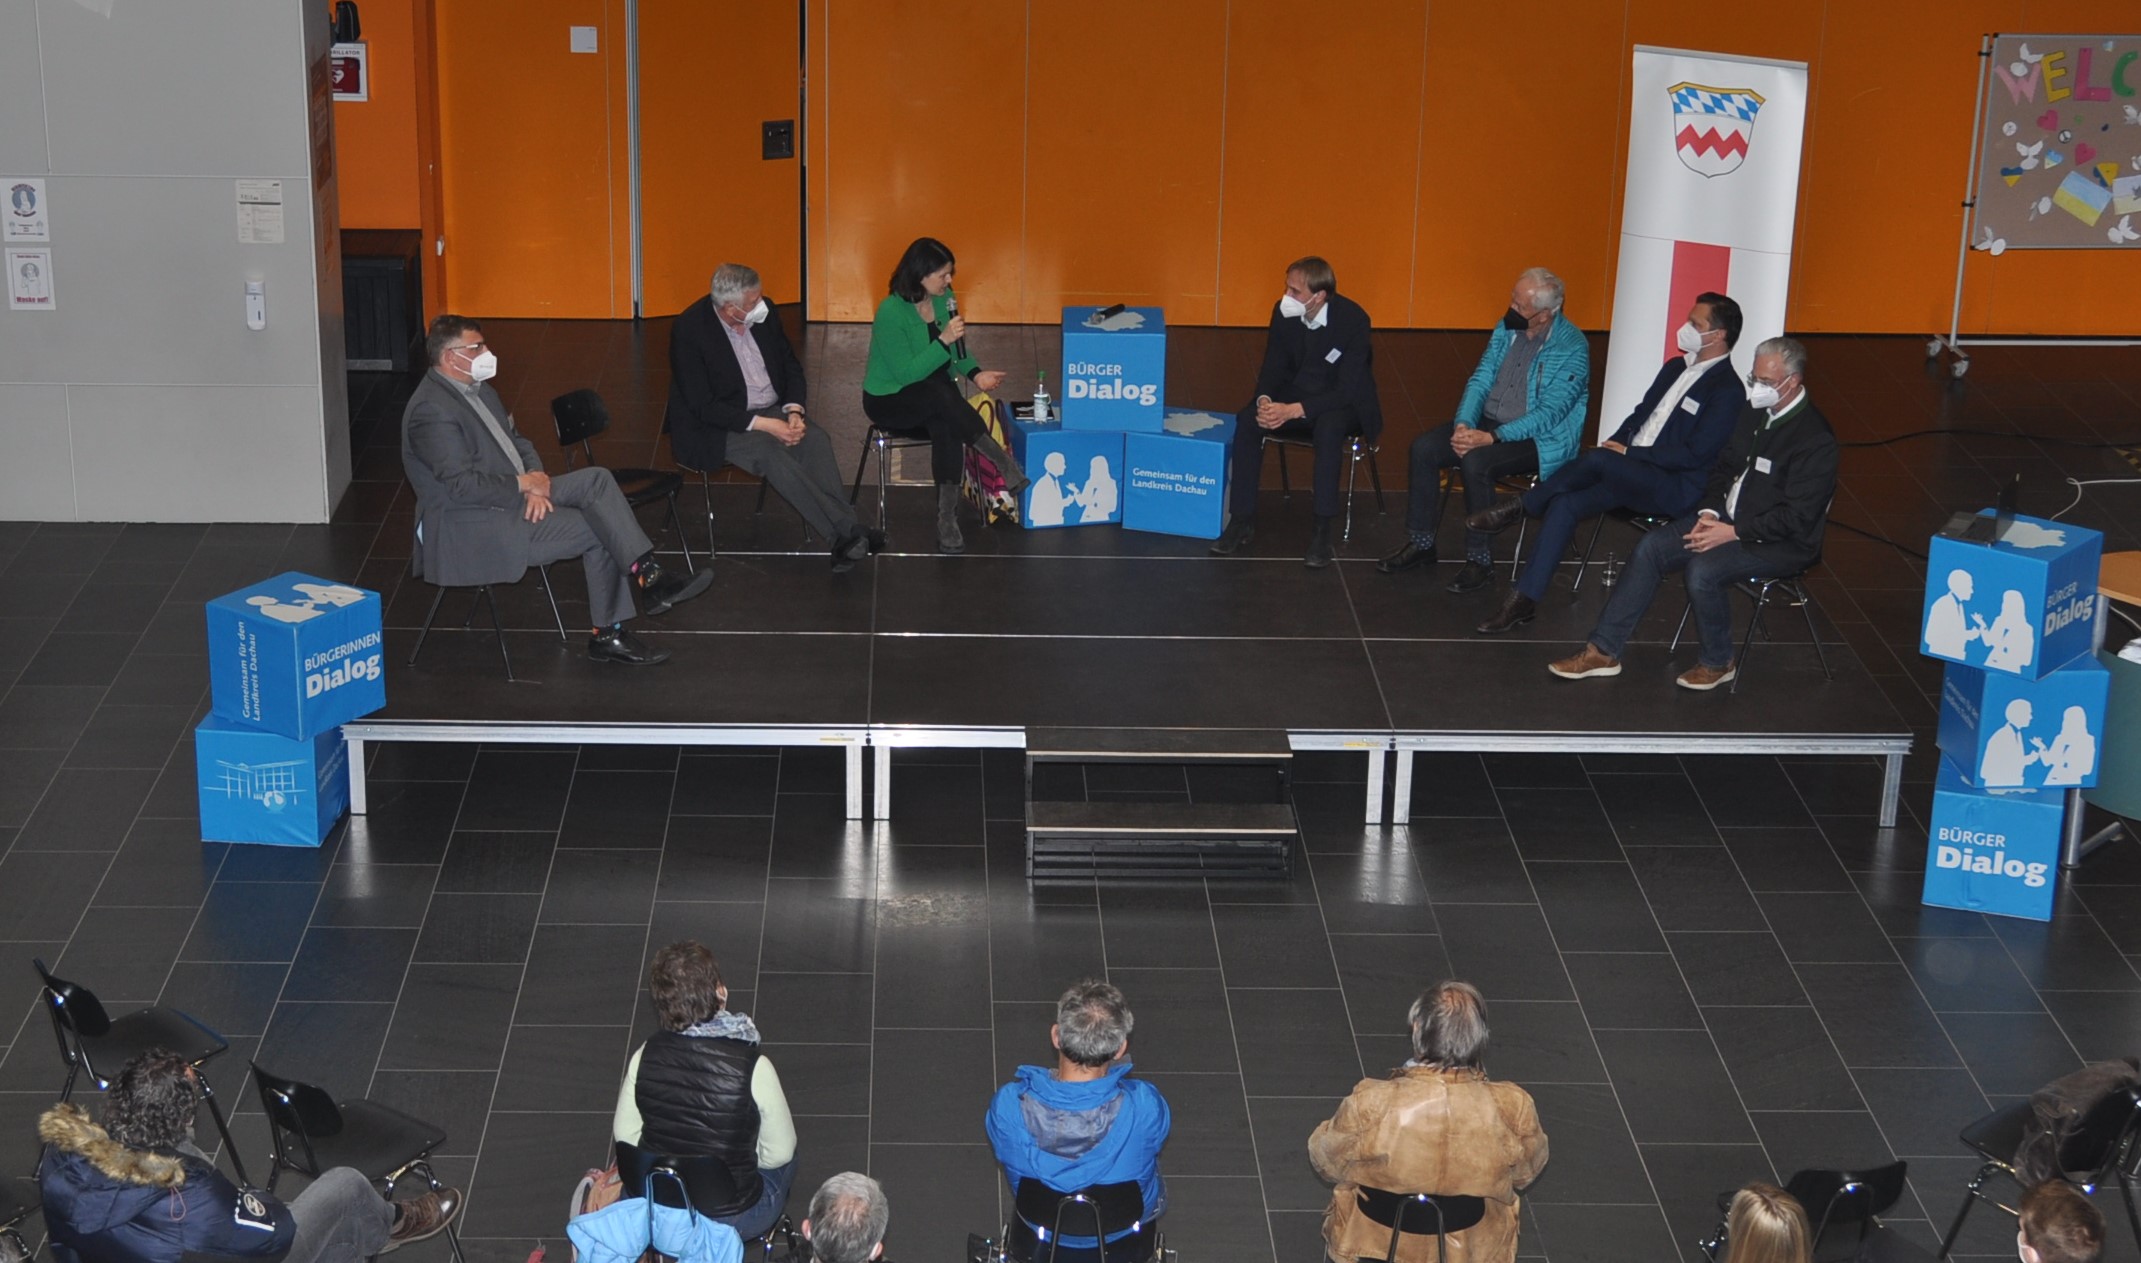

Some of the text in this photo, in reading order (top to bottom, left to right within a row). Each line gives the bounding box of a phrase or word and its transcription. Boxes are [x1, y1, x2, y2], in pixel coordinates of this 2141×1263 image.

[1068, 362, 1122, 376] BÜRGER
[1068, 378, 1157, 406] Dialog
[1132, 479, 1207, 495] Landkreis Dachau
[1133, 468, 1216, 485] Gemeinsam für den
[2047, 581, 2078, 608] BÜRGER
[2044, 594, 2095, 637] Dialog
[305, 631, 381, 672] BÜRGERINNEN
[238, 621, 250, 718] Gemeinsam für den
[249, 634, 260, 721] Landkreis Dachau
[306, 654, 381, 699] Dialog
[1939, 826, 2006, 847] BÜRGER
[1936, 845, 2048, 887] Dialog
